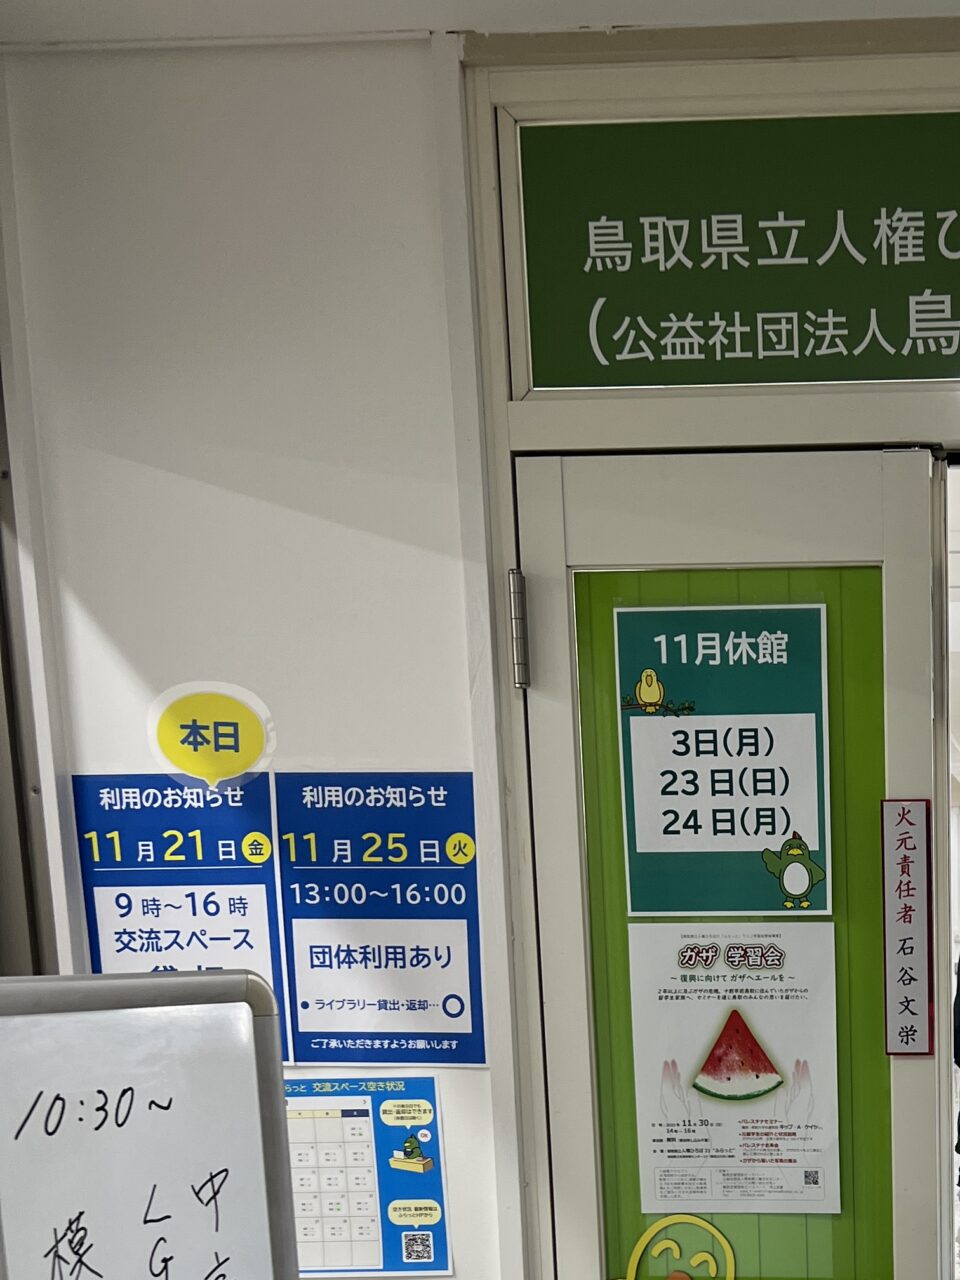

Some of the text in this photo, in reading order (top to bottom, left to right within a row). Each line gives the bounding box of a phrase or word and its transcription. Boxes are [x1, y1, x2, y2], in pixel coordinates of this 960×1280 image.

[653, 630, 789, 666] 11月休館
[179, 718, 241, 754] 本日
[671, 726, 775, 758] 3日(月)
[99, 785, 245, 811] 利用のお知らせ
[301, 785, 449, 809] 利用のお知らせ
[893, 805, 919, 1046] 火元責任者 石谷文栄
[113, 927, 254, 954] 交流スペース
[308, 943, 453, 971] 団体利用あり
[680, 943, 786, 969] ガザ 学習会
[310, 1038, 459, 1050] ご了承いただきますようお願いします
[311, 1080, 406, 1093] 交流スペース空き状況
